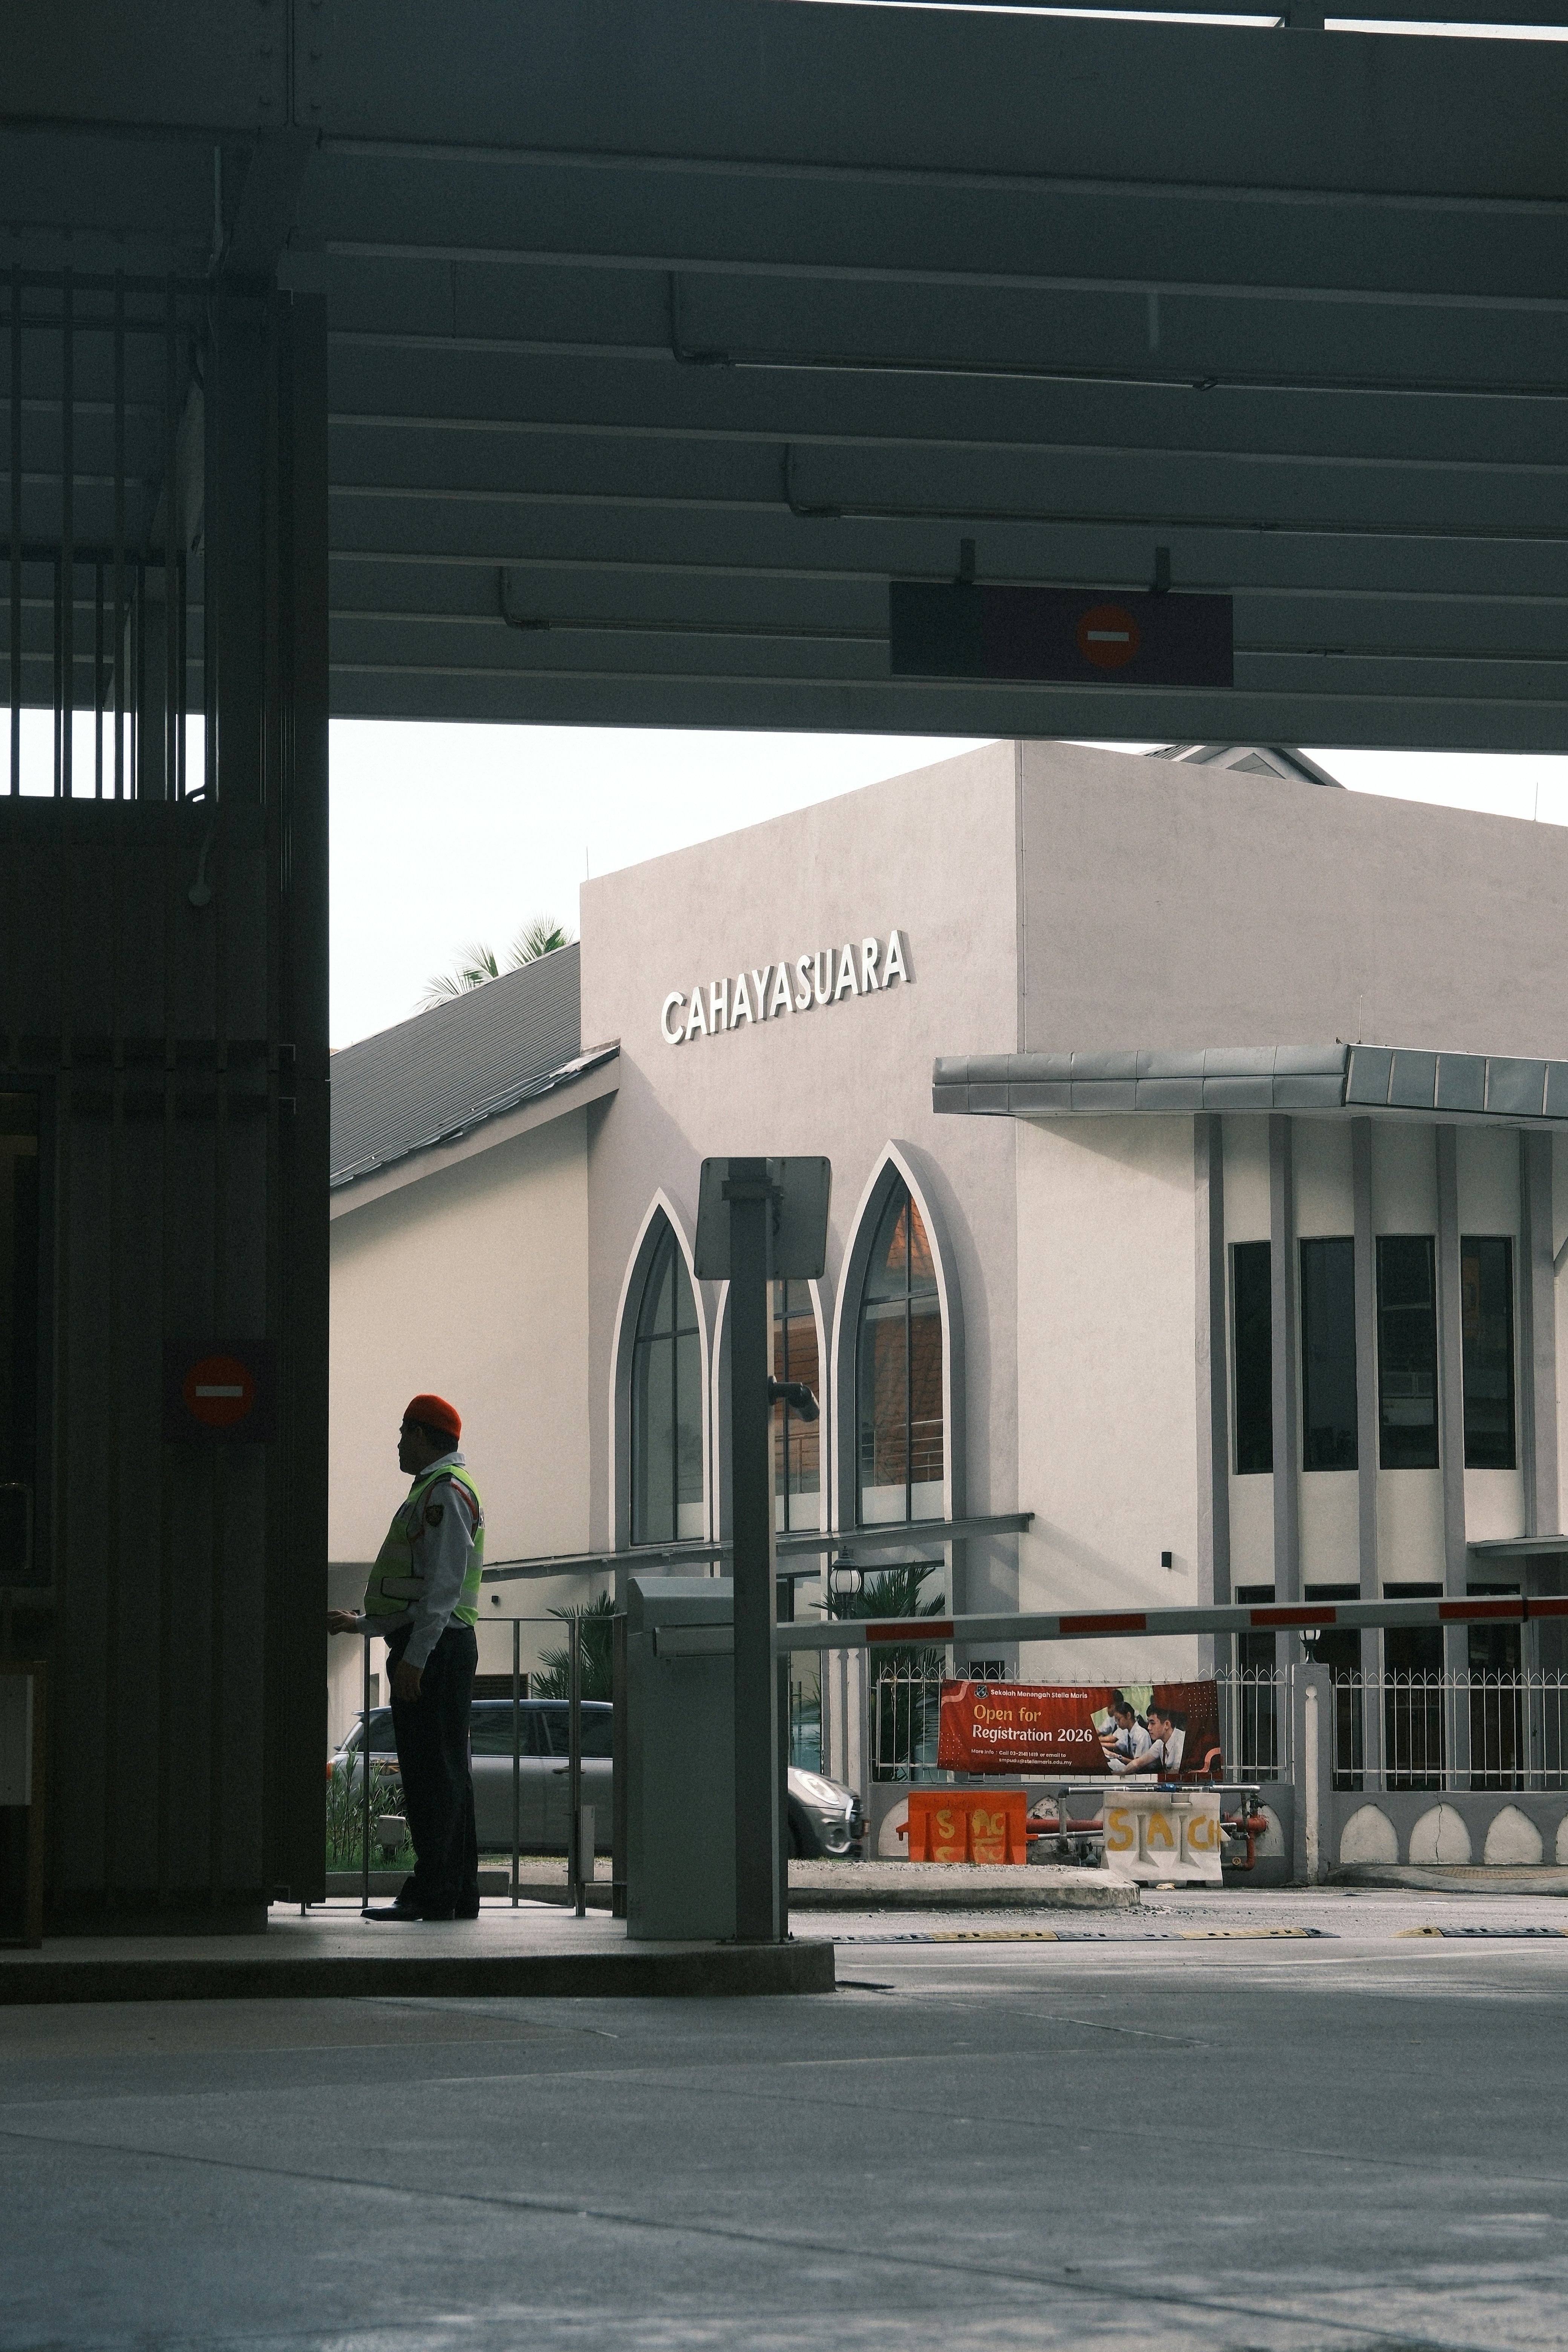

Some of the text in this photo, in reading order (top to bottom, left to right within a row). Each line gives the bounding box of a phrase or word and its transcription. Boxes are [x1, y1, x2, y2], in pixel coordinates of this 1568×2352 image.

[661, 929, 911, 1044] CAHAYASUARA
[1017, 1690, 1050, 1699] Menengah
[974, 1704, 1041, 1724] Open for
[972, 1724, 1093, 1743] Registration 2026
[999, 1758, 1072, 1766] smpudu@stellamaris.edu.my
